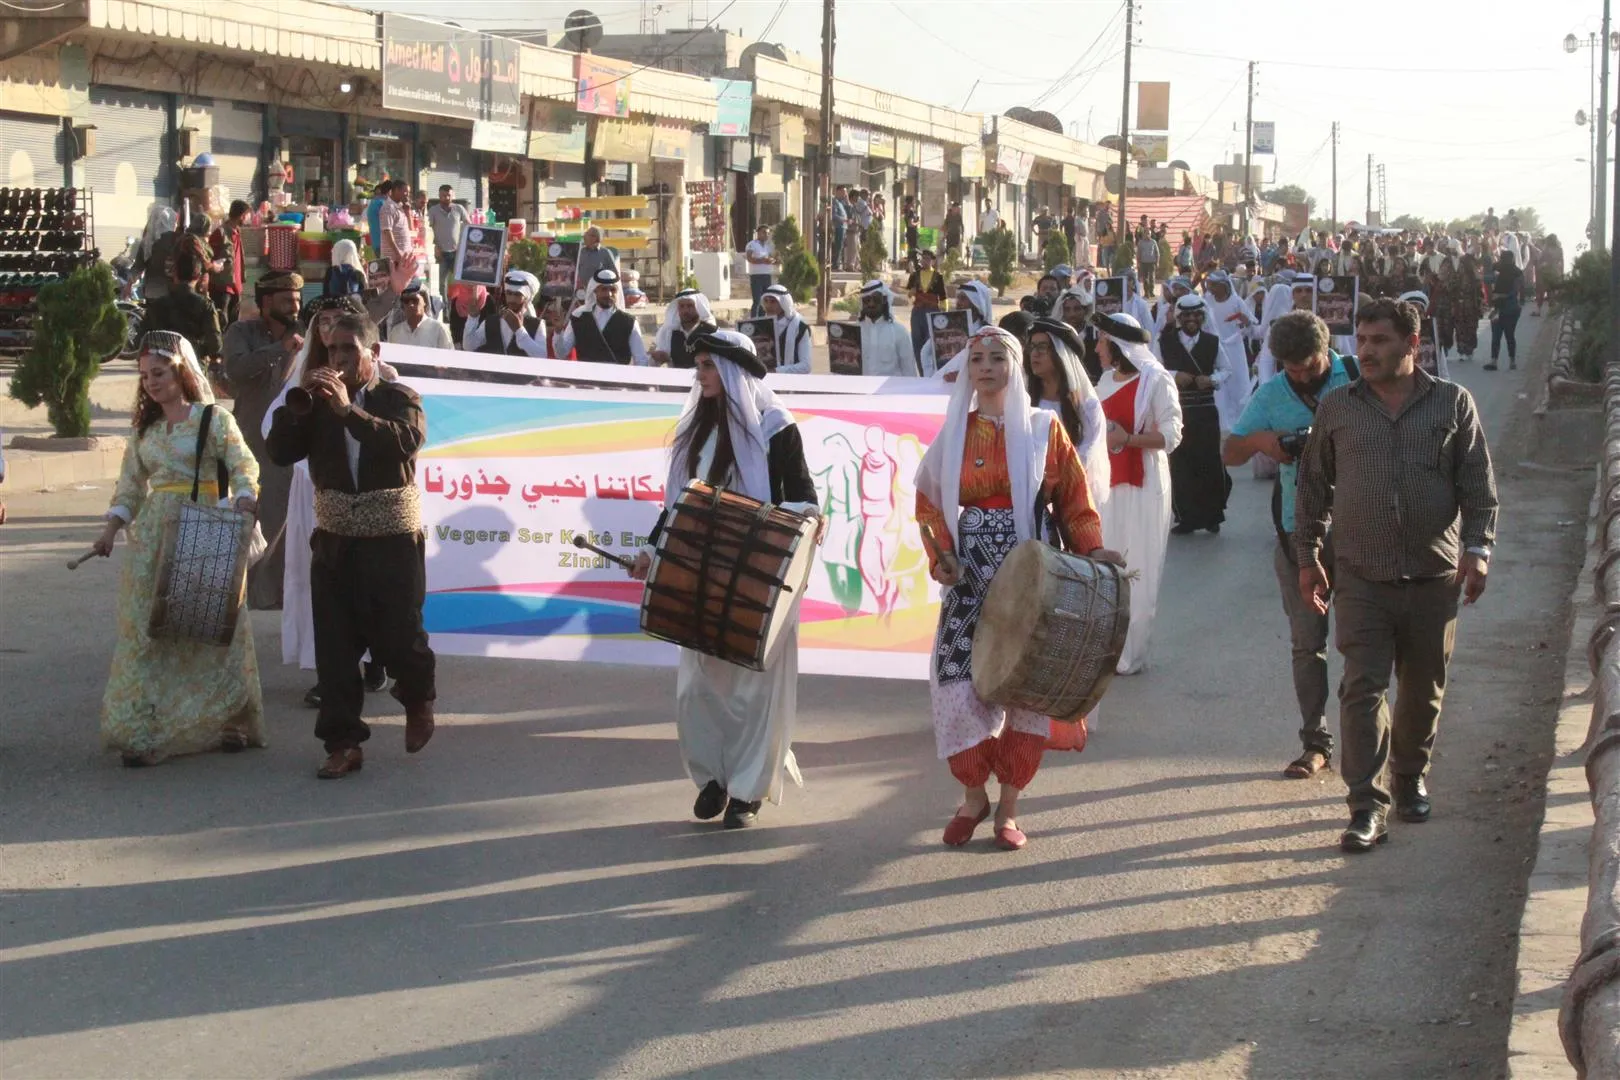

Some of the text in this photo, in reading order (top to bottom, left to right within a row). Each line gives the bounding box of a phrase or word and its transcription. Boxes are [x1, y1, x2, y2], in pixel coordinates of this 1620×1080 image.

[386, 36, 444, 73] Amed Mall
[424, 466, 511, 501] جذورنا
[521, 474, 587, 509] نحيي
[435, 525, 510, 545] Vegera
[518, 528, 553, 543] Ser
[560, 529, 613, 546] Kkê
